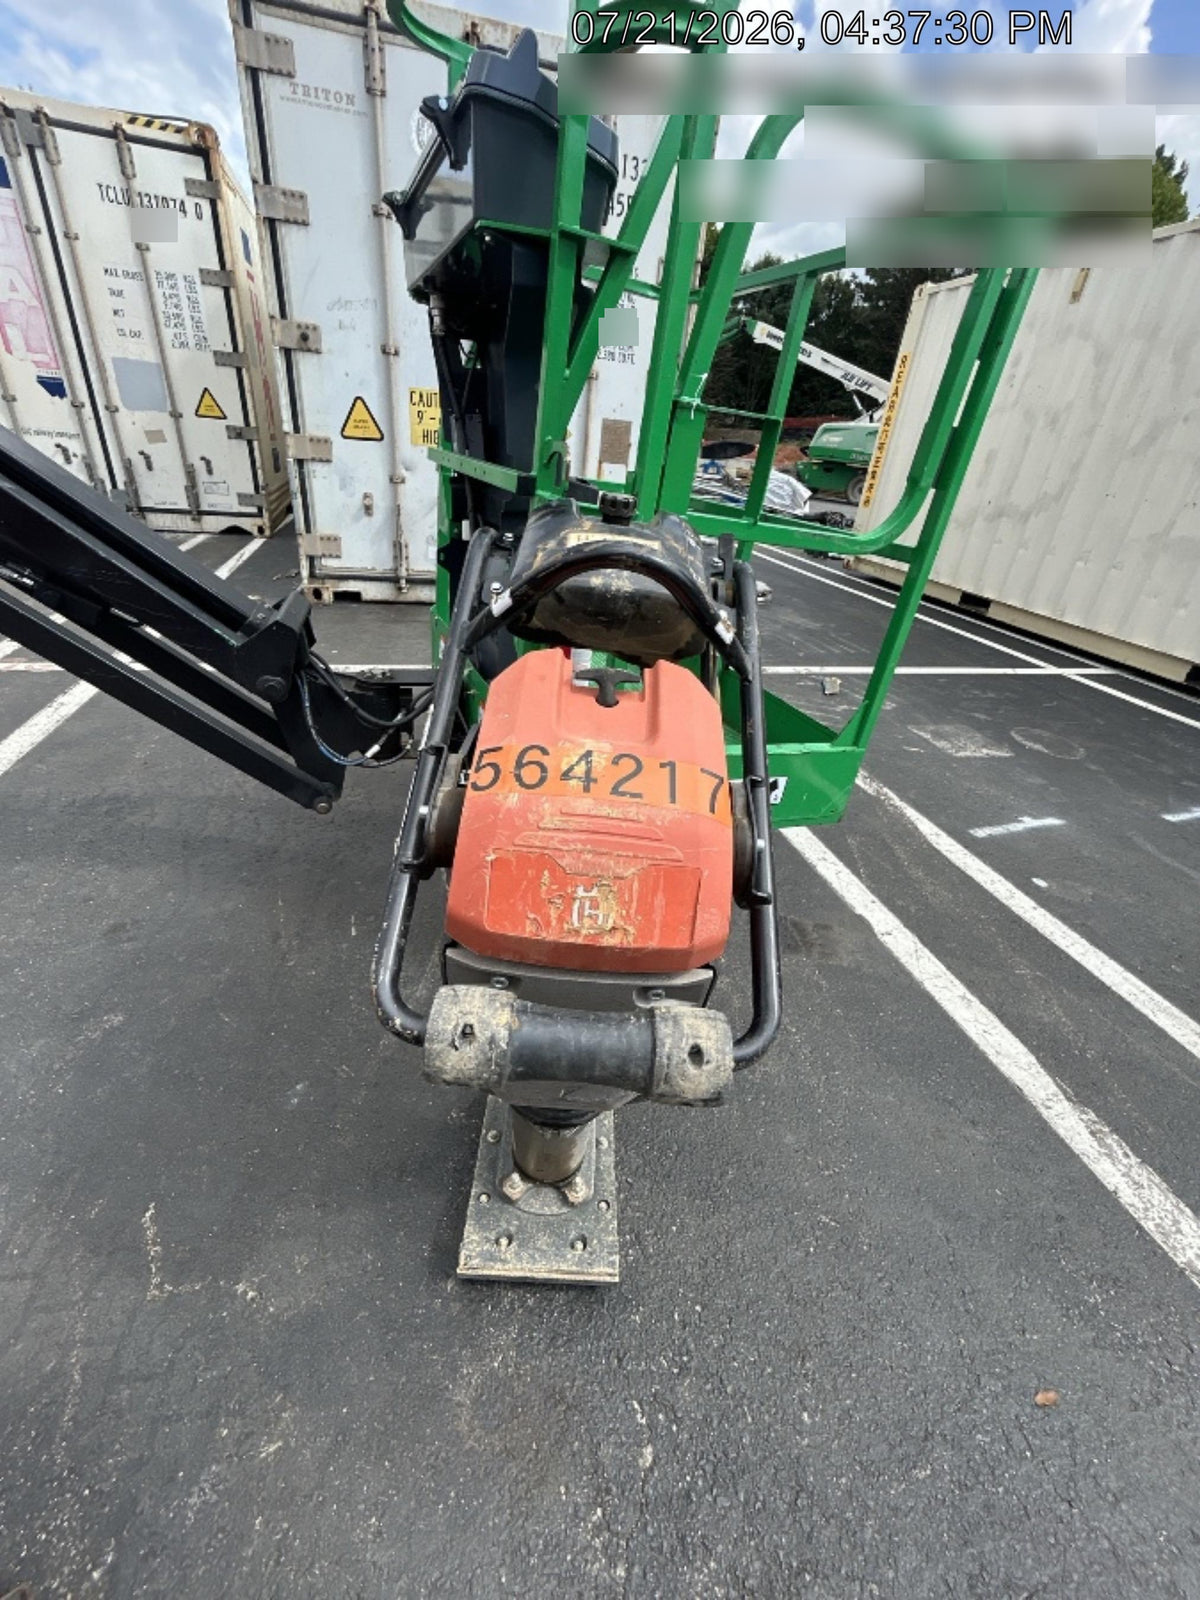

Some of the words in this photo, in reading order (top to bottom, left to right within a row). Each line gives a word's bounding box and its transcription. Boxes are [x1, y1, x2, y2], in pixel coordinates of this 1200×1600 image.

[289, 82, 356, 107] TRITON
[96, 182, 130, 208] TCLU
[470, 744, 725, 814] 564217
